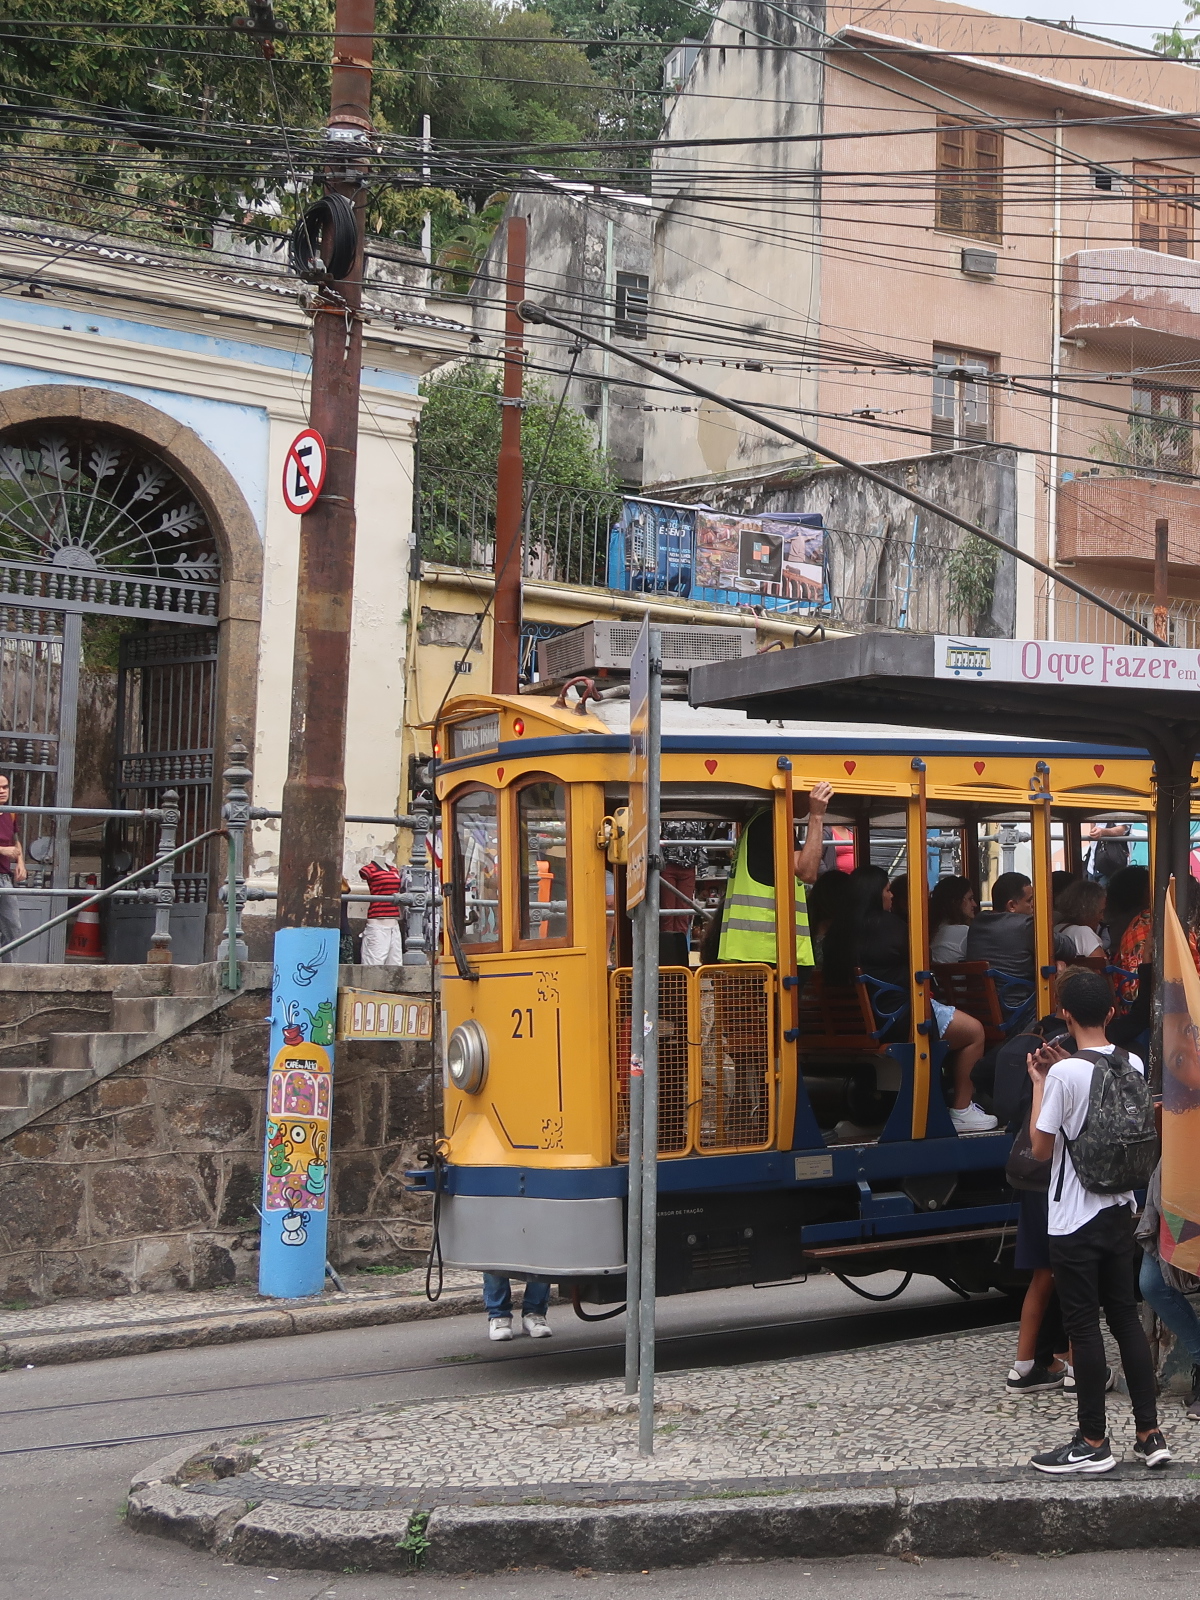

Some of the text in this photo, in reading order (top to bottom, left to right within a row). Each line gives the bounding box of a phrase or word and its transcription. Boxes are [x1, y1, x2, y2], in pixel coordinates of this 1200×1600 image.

[1021, 641, 1042, 680] O
[1047, 652, 1095, 682] que
[1100, 646, 1177, 683] Fazer
[1177, 667, 1198, 681] em
[511, 1008, 533, 1039] 21
